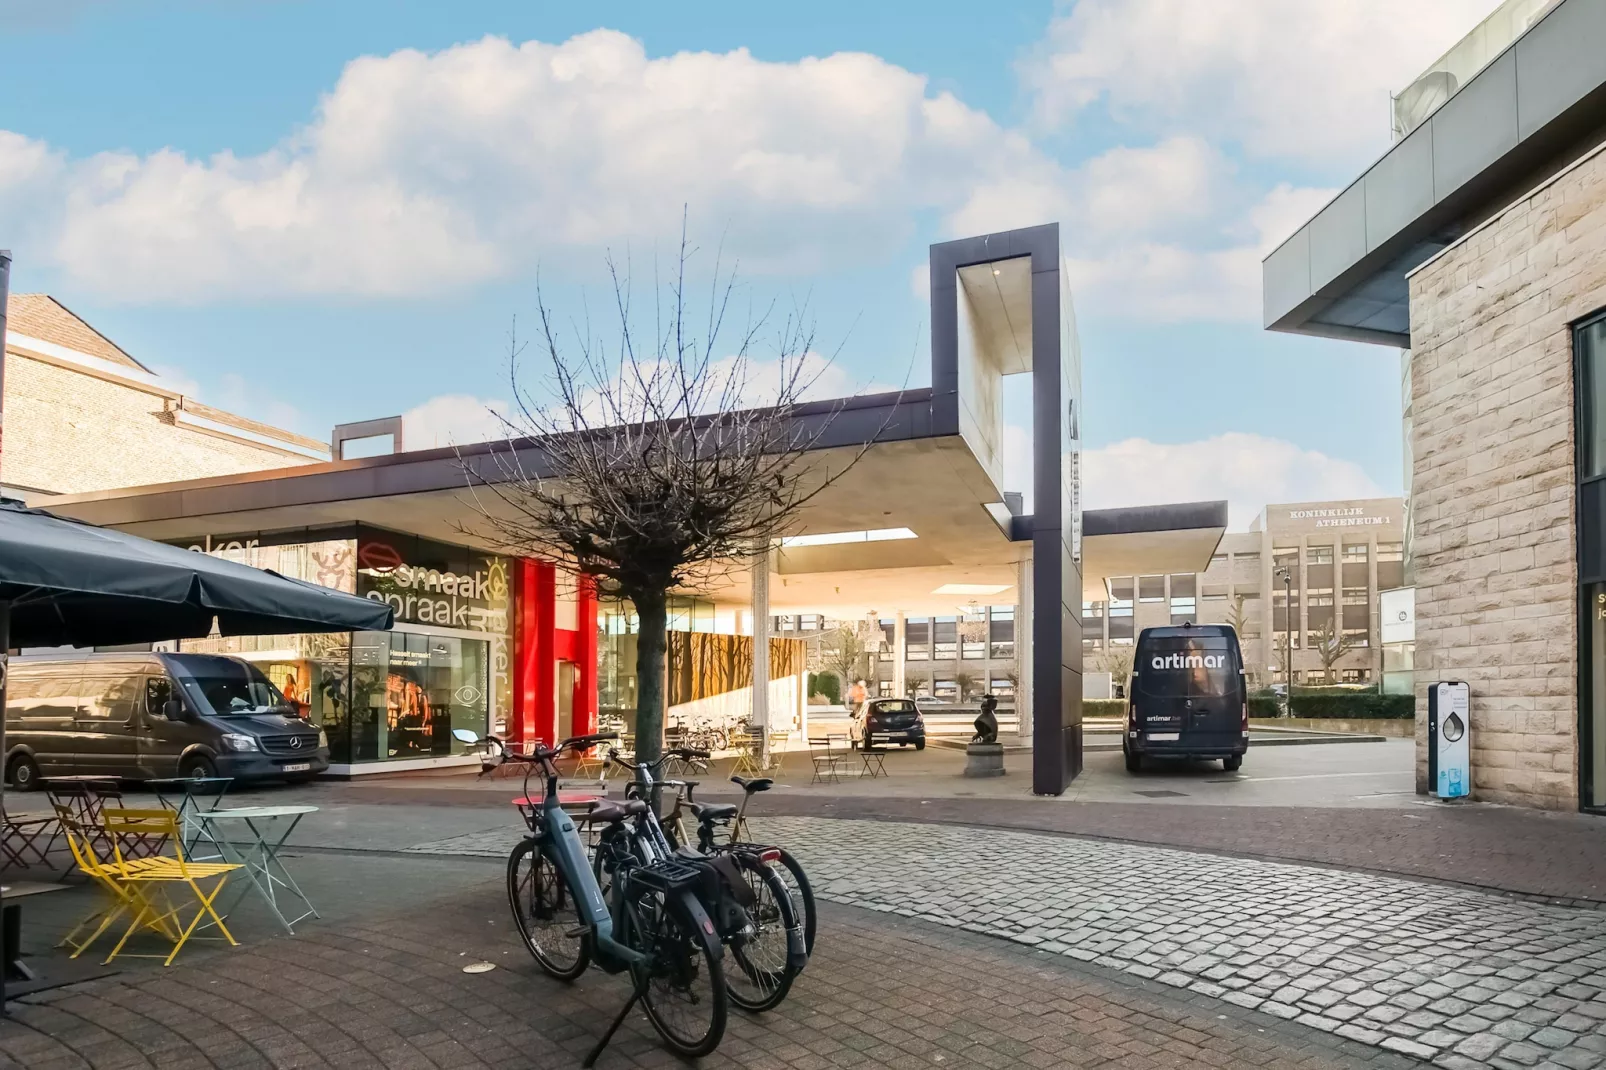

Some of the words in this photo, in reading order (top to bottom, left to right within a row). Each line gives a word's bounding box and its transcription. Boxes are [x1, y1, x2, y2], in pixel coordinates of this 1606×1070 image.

[1290, 507, 1364, 519] KONINKLIJK
[1315, 516, 1382, 528] ATHENEUM
[395, 563, 489, 601] smaak
[1151, 652, 1225, 670] artimar
